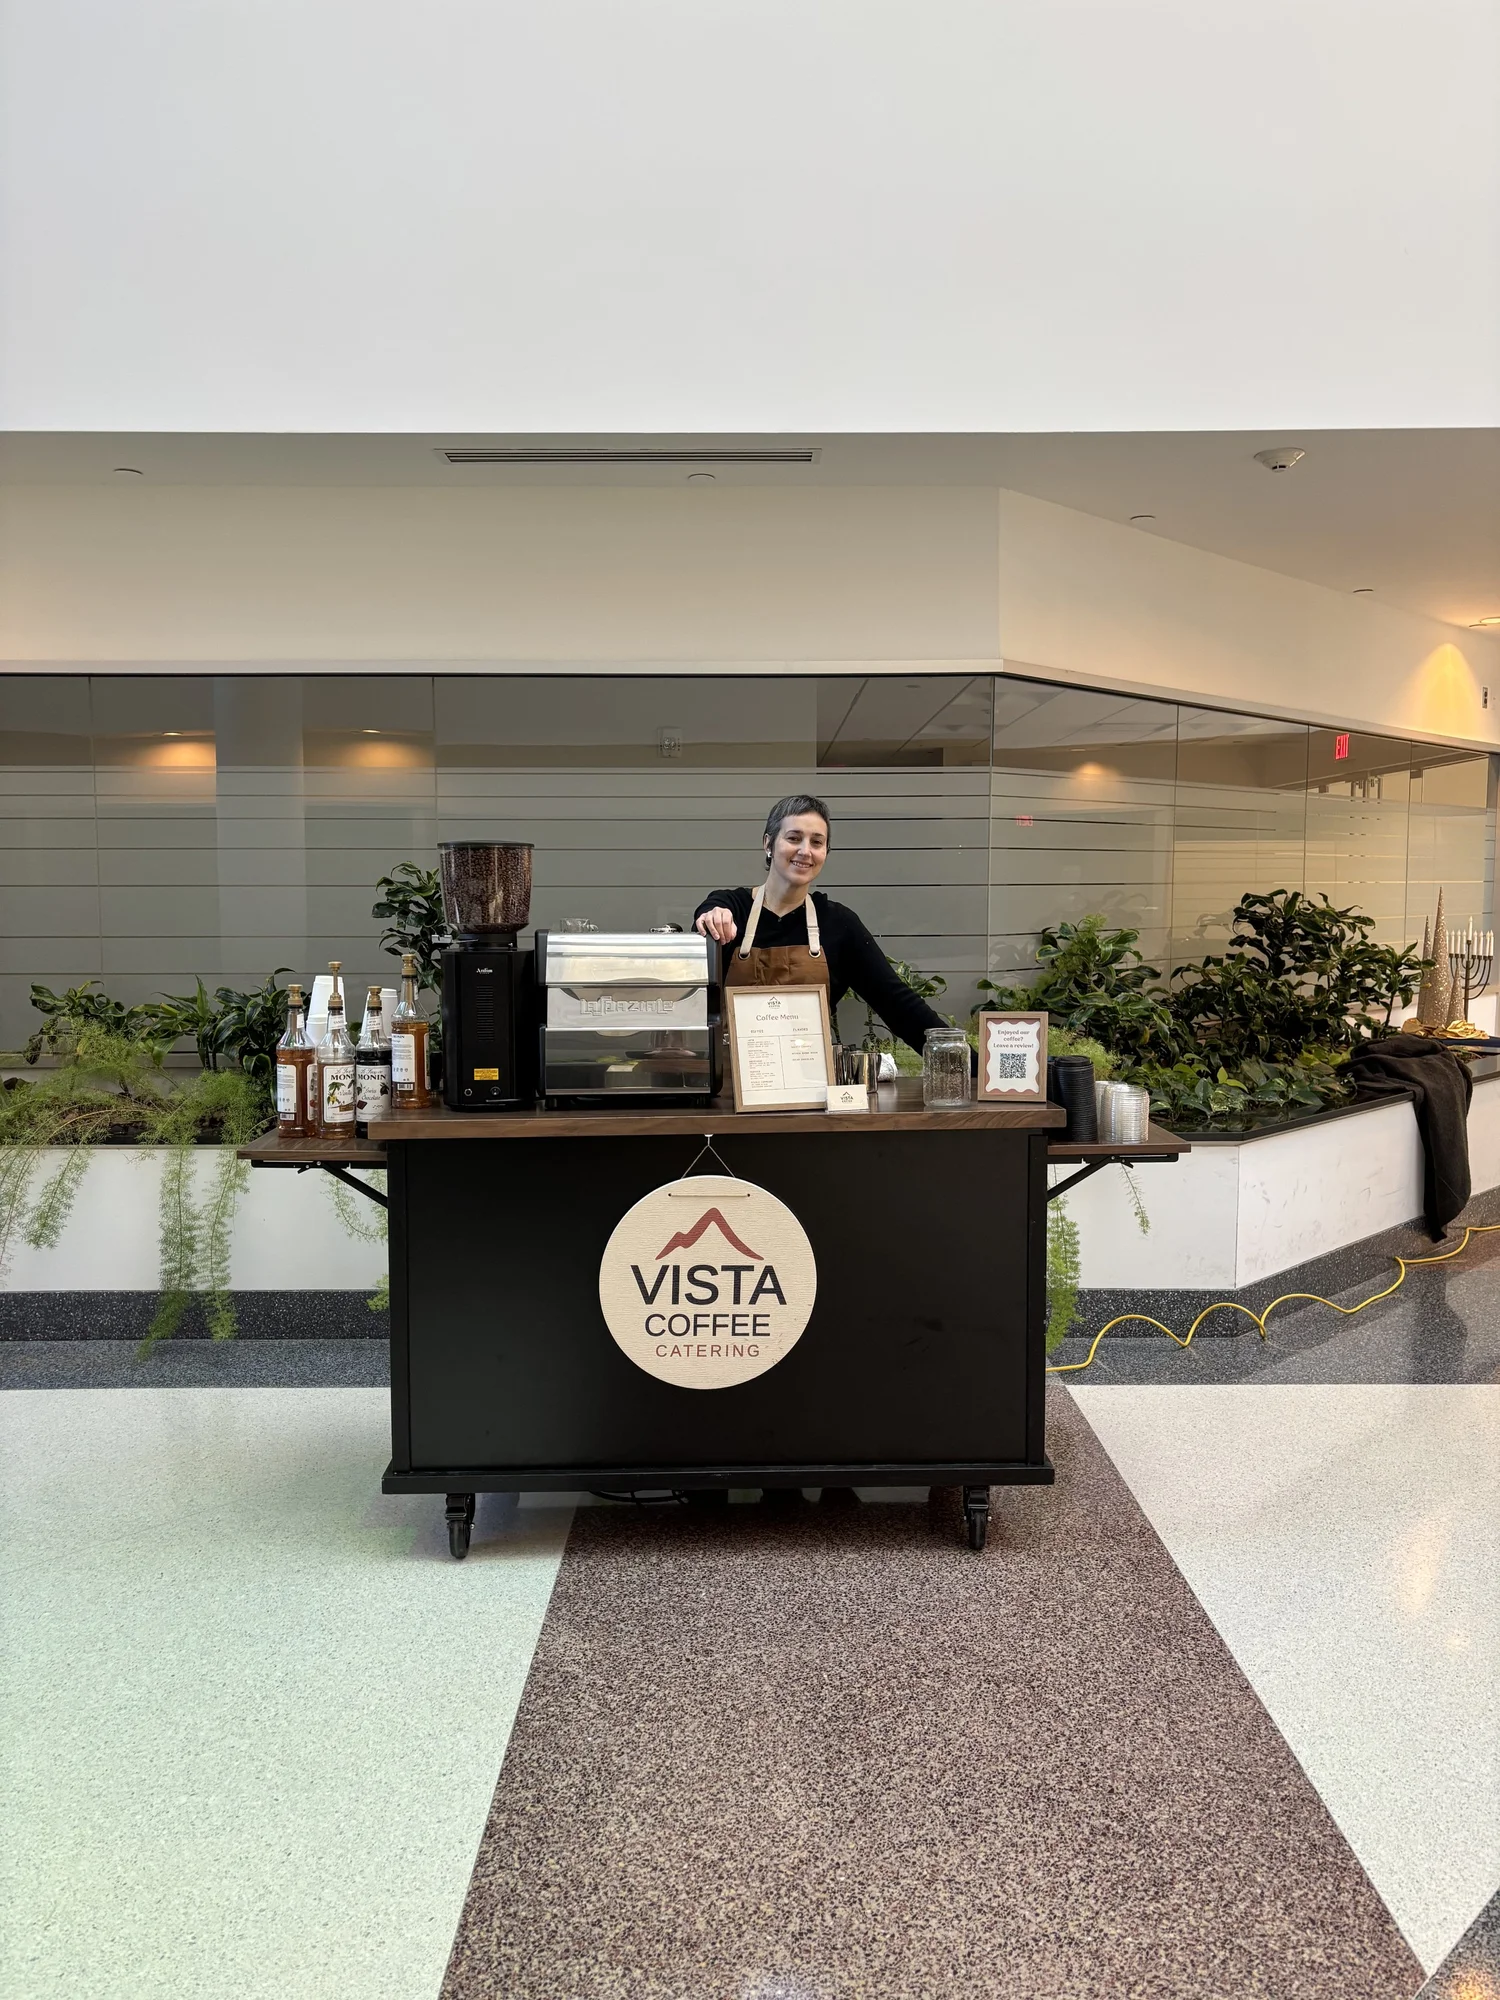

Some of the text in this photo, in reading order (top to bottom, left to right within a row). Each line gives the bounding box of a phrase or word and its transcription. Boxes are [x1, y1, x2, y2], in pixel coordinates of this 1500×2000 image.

[1335, 733, 1349, 760] EXIT
[630, 1264, 787, 1306] VISTA
[644, 1313, 771, 1337] COFFEE
[655, 1344, 760, 1358] CATERING
